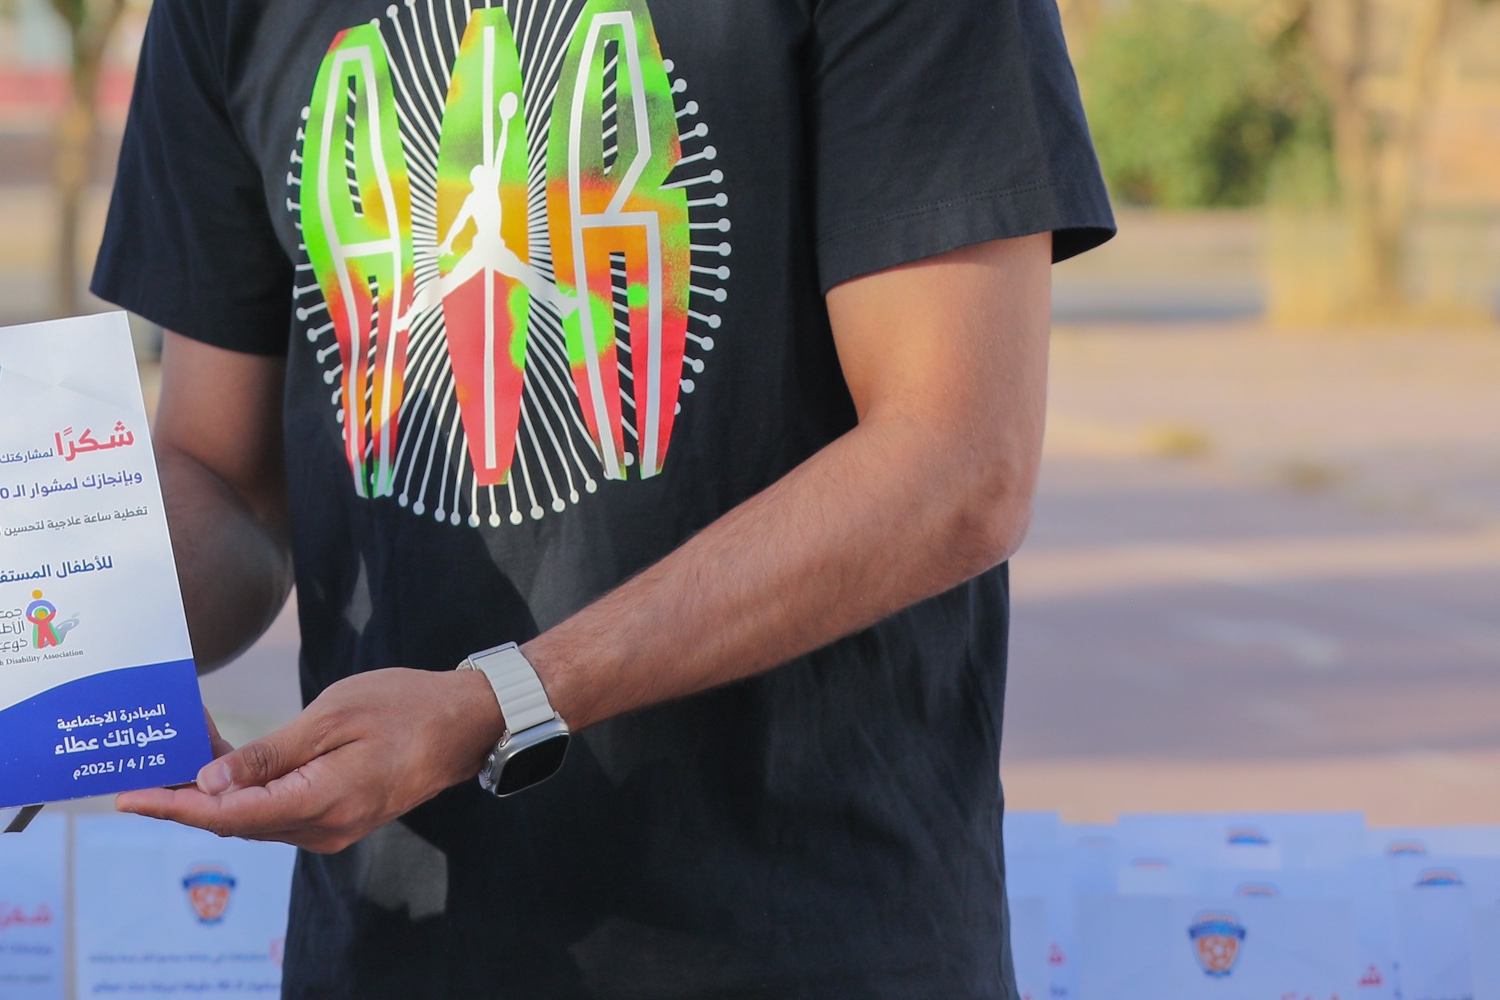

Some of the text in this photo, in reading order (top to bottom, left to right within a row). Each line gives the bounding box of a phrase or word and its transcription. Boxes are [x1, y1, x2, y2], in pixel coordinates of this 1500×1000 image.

[0, 447, 54, 464] لمشاركتك
[29, 476, 79, 499] لمشوار
[82, 470, 144, 490] وبإنجازك
[83, 512, 112, 524] ساعة
[113, 505, 149, 522] تغطية
[3, 520, 45, 538] لتحسين
[47, 516, 82, 532] علاجية
[55, 555, 114, 580] للأطفال
[5, 654, 41, 667] Disability
[42, 649, 85, 662] Association
[56, 703, 167, 732] المبادرة الاجتماعية
[54, 722, 179, 755] خطواتك عطاء
[126, 758, 137, 770] 4
[147, 753, 166, 767] 26
